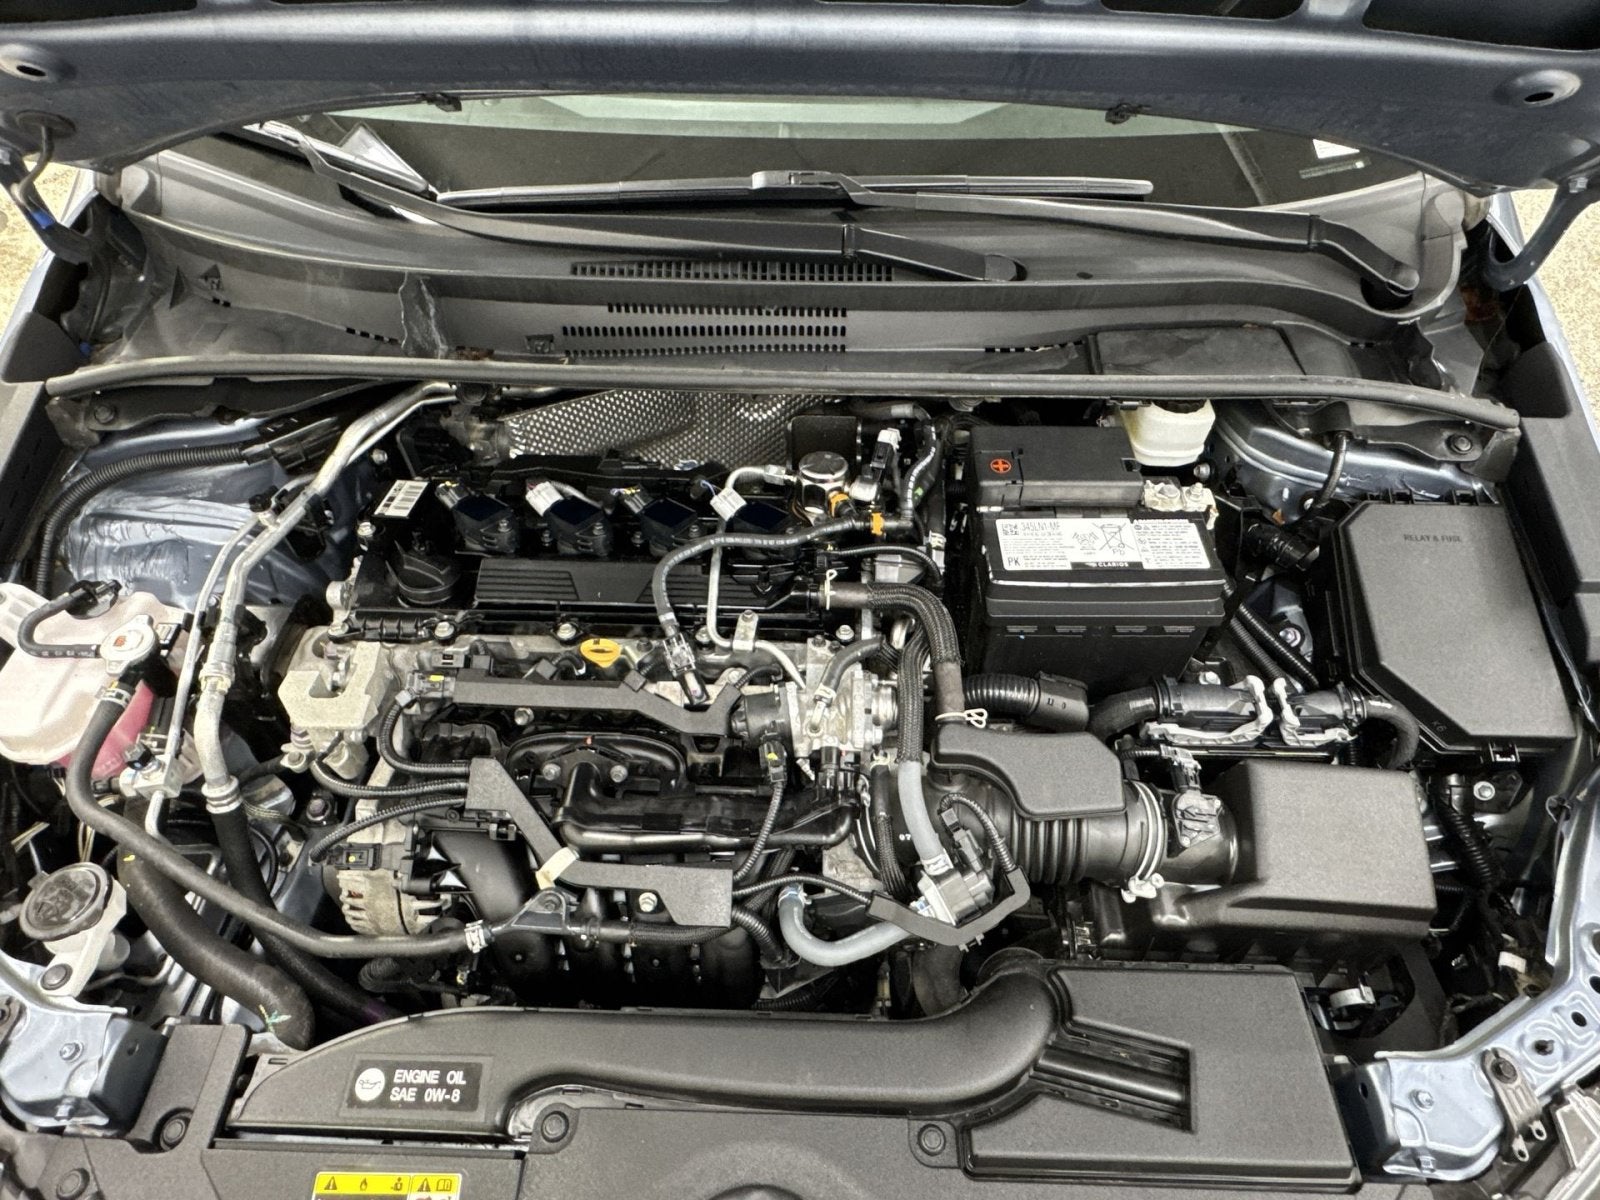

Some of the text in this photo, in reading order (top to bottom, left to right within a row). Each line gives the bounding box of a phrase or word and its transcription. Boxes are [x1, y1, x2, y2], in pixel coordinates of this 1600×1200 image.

[1007, 556, 1021, 567] PK
[393, 1069, 467, 1085] ENGINE OIL
[389, 1087, 461, 1103] SAE 0W-8
